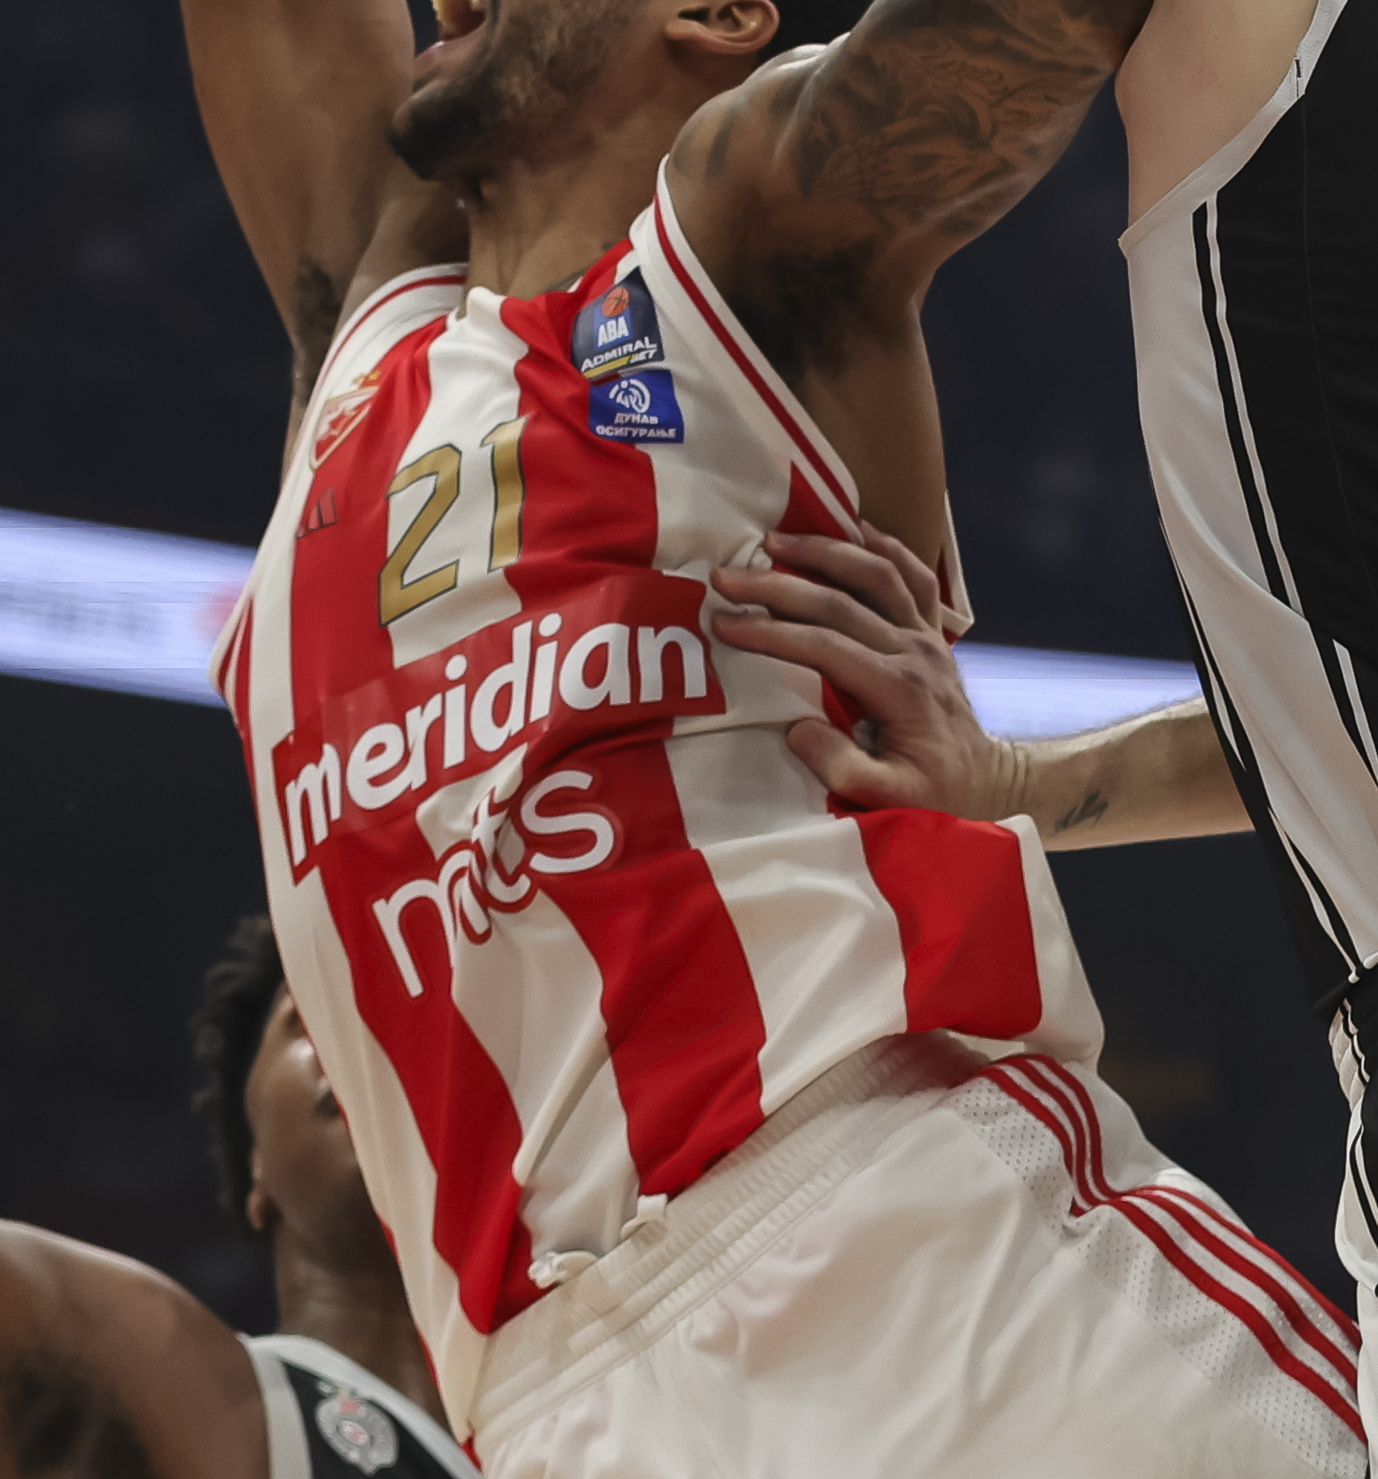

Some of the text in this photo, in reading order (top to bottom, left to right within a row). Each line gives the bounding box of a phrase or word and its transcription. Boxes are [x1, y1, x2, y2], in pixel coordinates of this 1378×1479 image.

[581, 336, 657, 372] ADMIRAL
[598, 316, 629, 347] ABA
[378, 415, 527, 628] 21
[284, 612, 707, 867] meridian
[372, 770, 615, 999] mts
